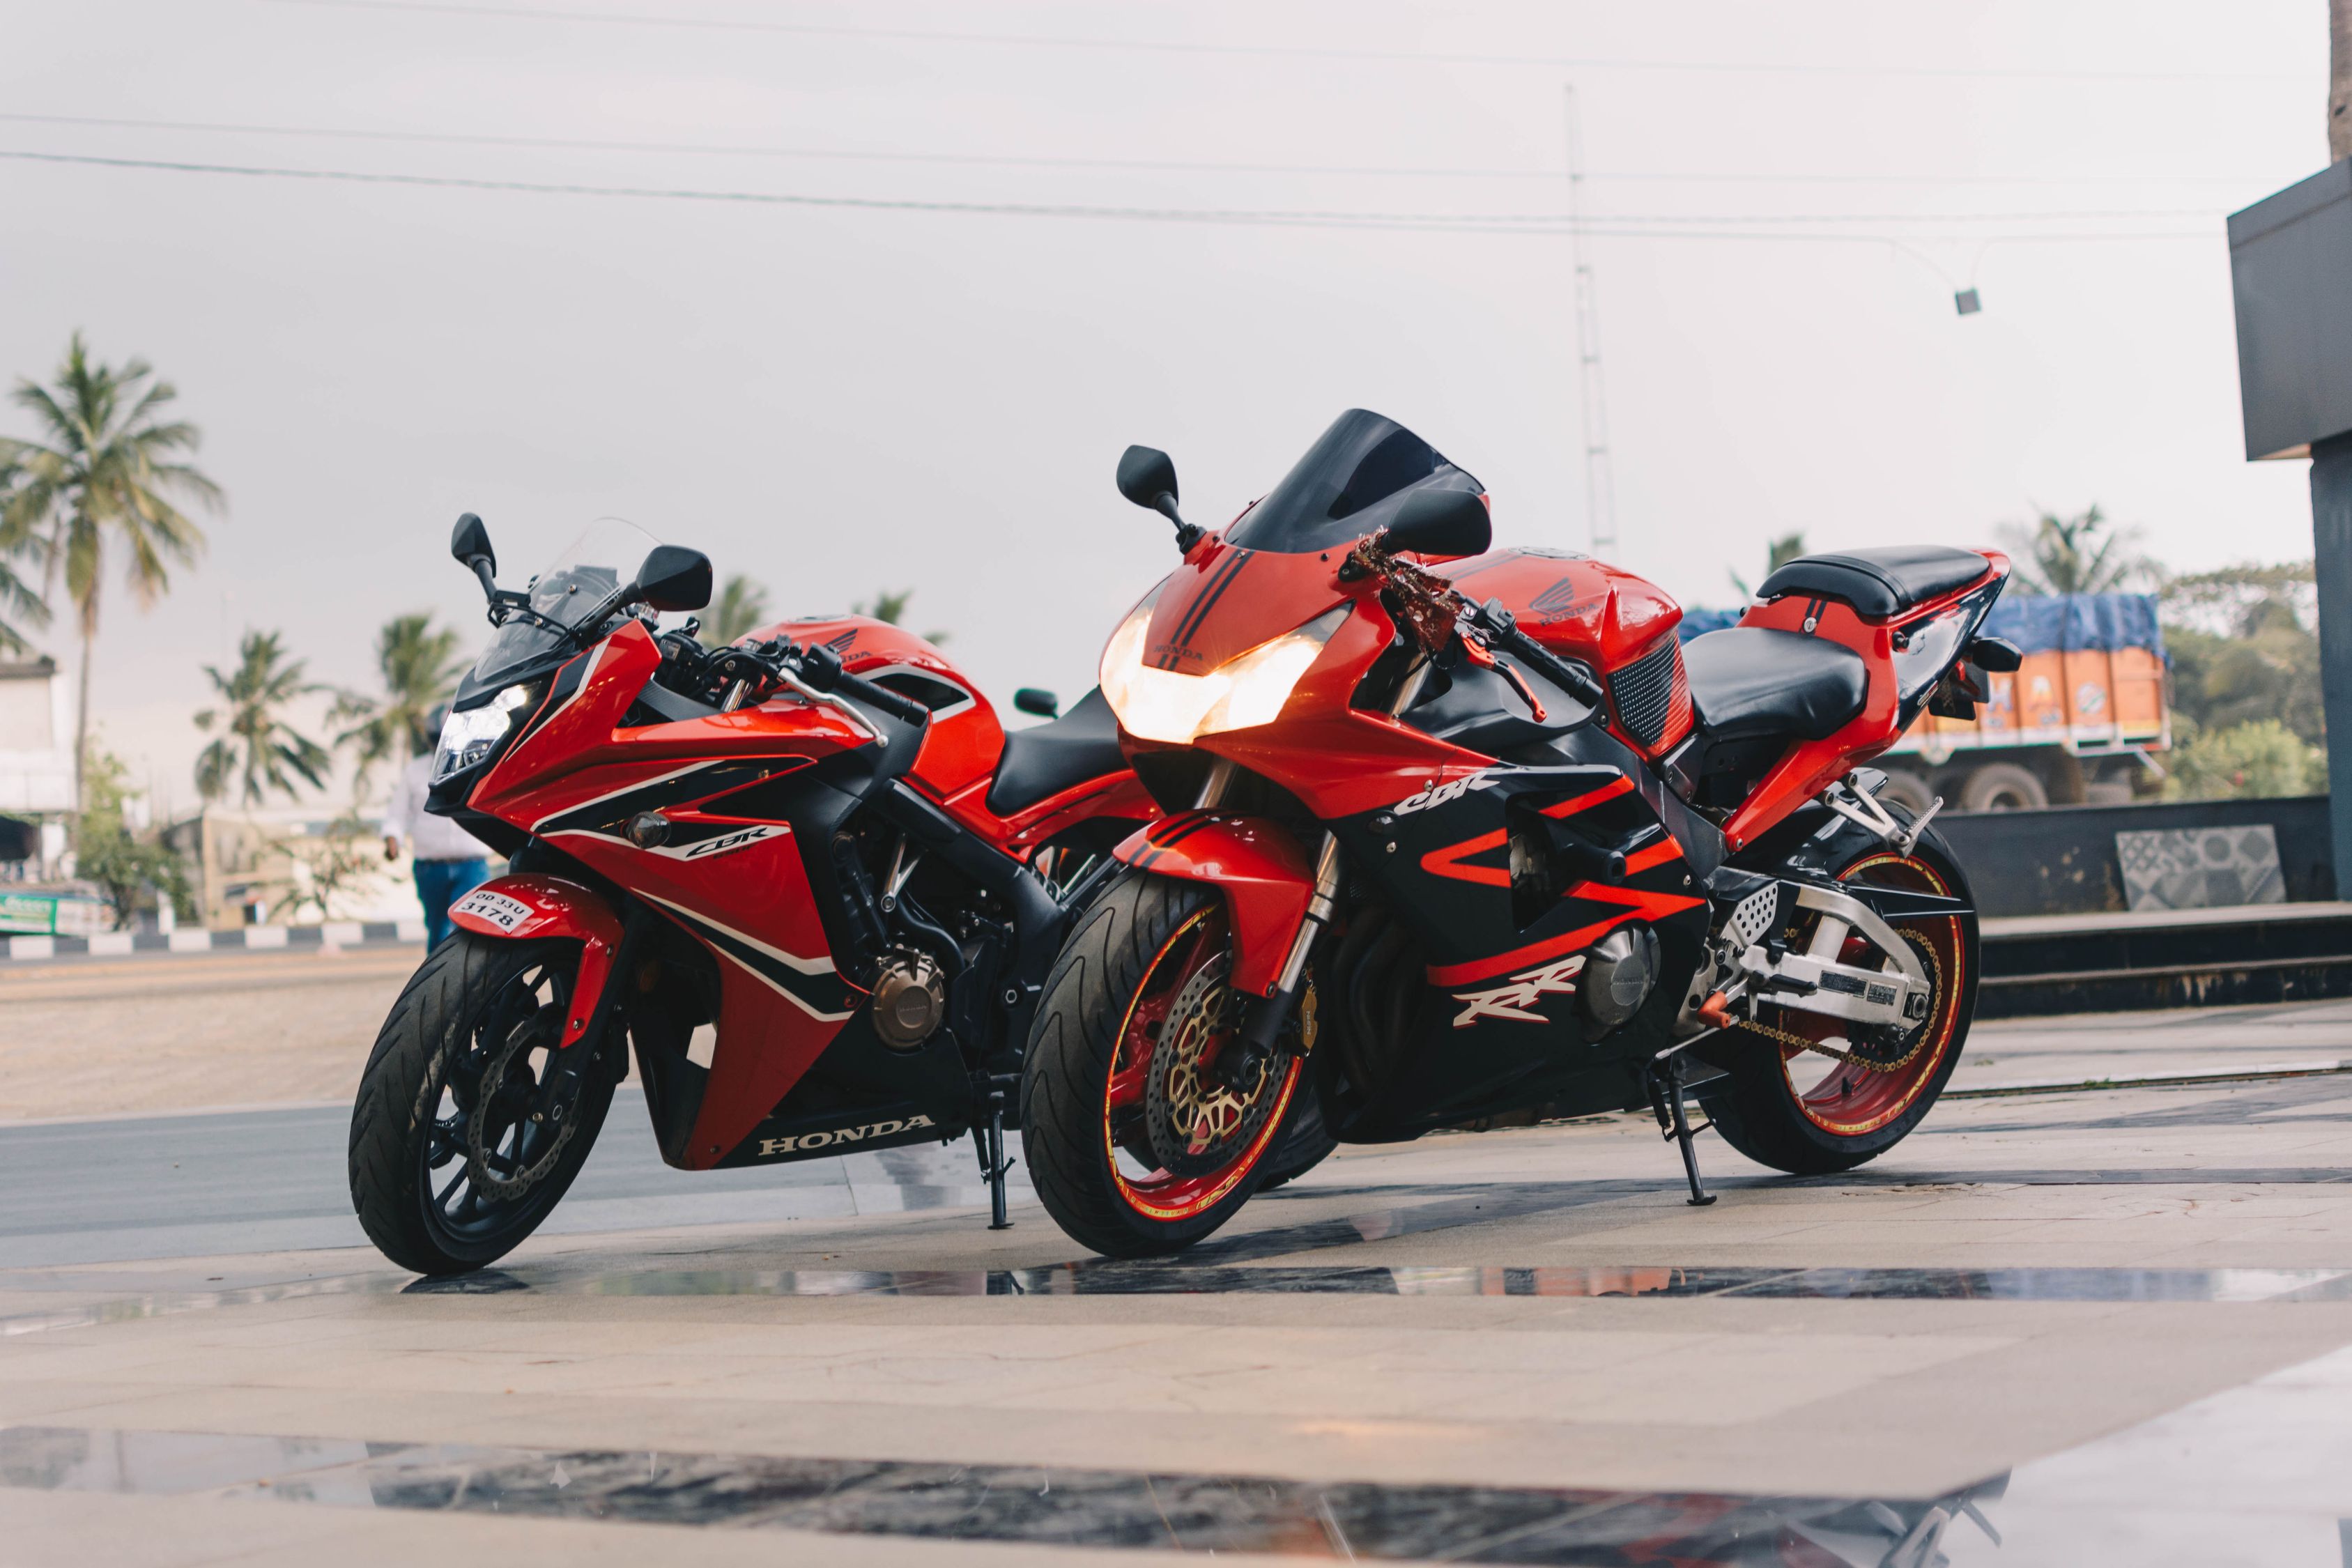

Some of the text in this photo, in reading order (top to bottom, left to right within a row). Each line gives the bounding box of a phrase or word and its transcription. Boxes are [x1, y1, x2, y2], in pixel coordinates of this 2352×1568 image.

[1539, 603, 1599, 626] HONDA
[1154, 645, 1204, 661] HONDA
[1394, 771, 1500, 816] CBR
[686, 827, 770, 859] CBR
[461, 902, 514, 926] 3178
[497, 898, 525, 914] 33U
[758, 1114, 936, 1156] HONDA
